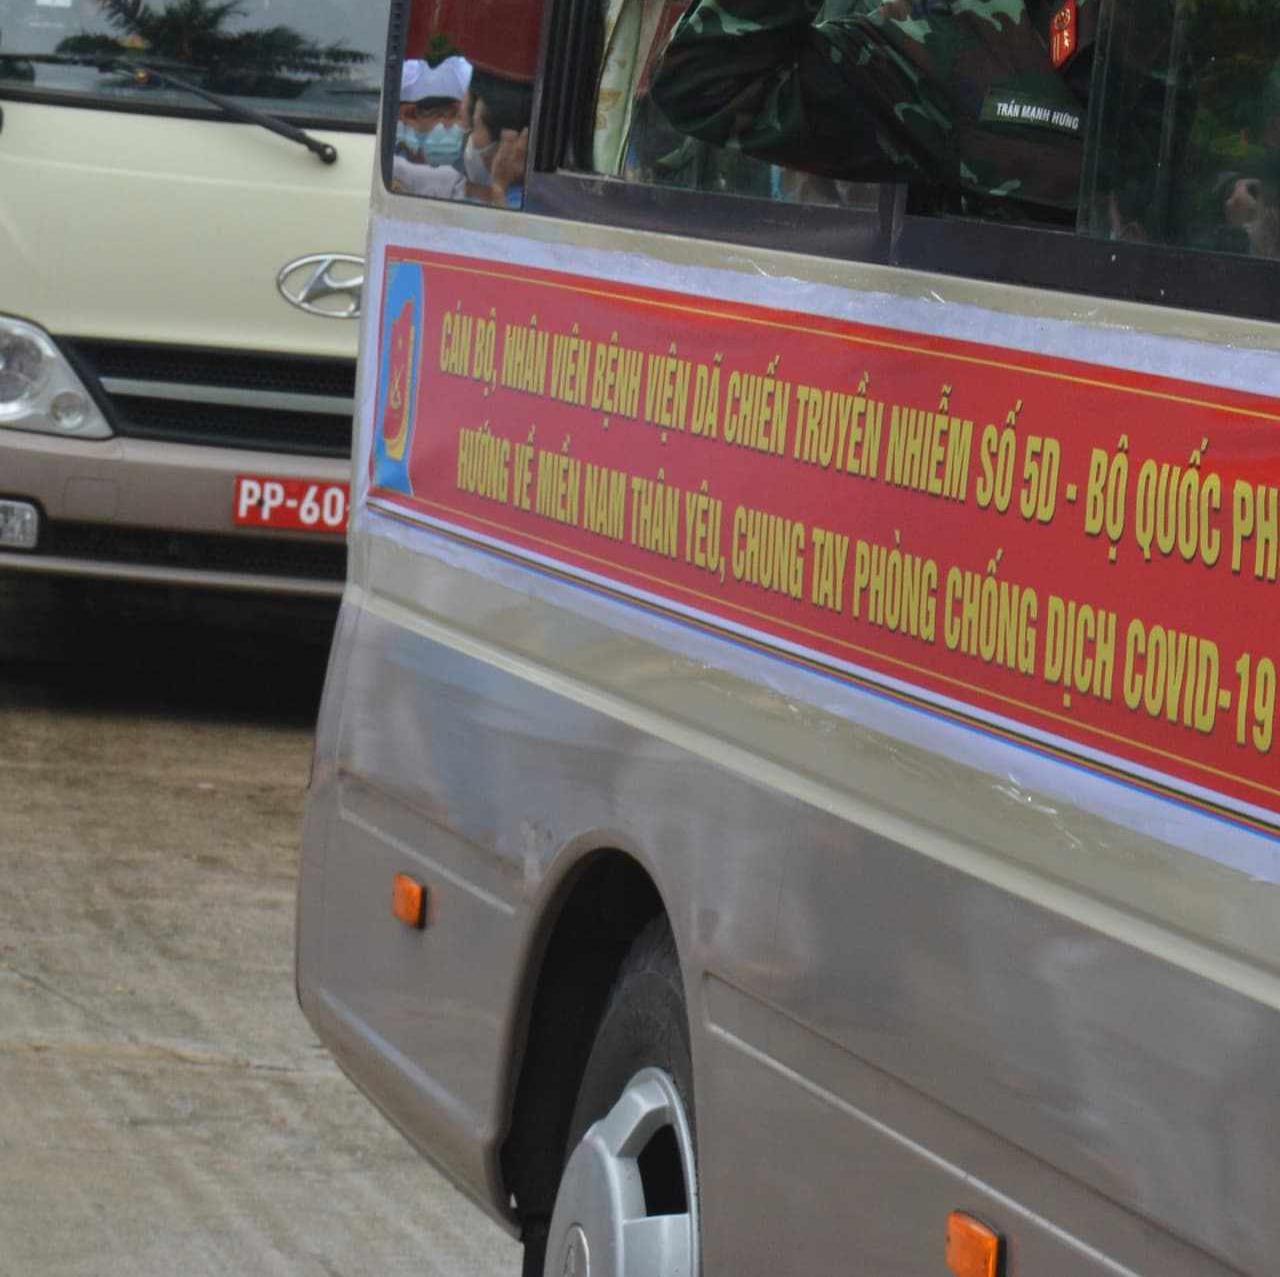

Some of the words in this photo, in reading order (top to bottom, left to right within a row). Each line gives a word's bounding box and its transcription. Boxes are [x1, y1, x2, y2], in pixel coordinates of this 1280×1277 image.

[239, 479, 351, 527] PP-60
[440, 300, 474, 377] CÁN
[473, 307, 497, 397] BỘ,
[501, 314, 549, 396] NHÂN
[550, 322, 591, 406] VIÊN
[591, 331, 644, 429] BỆNH
[645, 342, 691, 444] VIỆN
[691, 353, 722, 440] DÃ
[723, 355, 791, 456] CHIẾN
[794, 371, 884, 480] TRUYỀN
[885, 384, 974, 502] NHIỄM
[976, 399, 1022, 513] SỐ
[1021, 435, 1060, 523] 5D
[1066, 483, 1078, 502] -
[1085, 434, 1129, 561] BỘ
[1135, 437, 1221, 566] QUỐC
[457, 420, 510, 504] HƯỚNG
[536, 434, 581, 527] MIỀN
[584, 463, 627, 541] NAM
[631, 468, 680, 559] THÂN
[685, 480, 726, 584] YÊU,
[732, 506, 805, 600] CHUNG
[812, 527, 849, 612] TAY
[853, 529, 938, 643] PHÒNG
[944, 548, 1038, 675] CHỐNG
[1044, 594, 1117, 708] DỊCH
[1123, 619, 1277, 753] COVID-19
